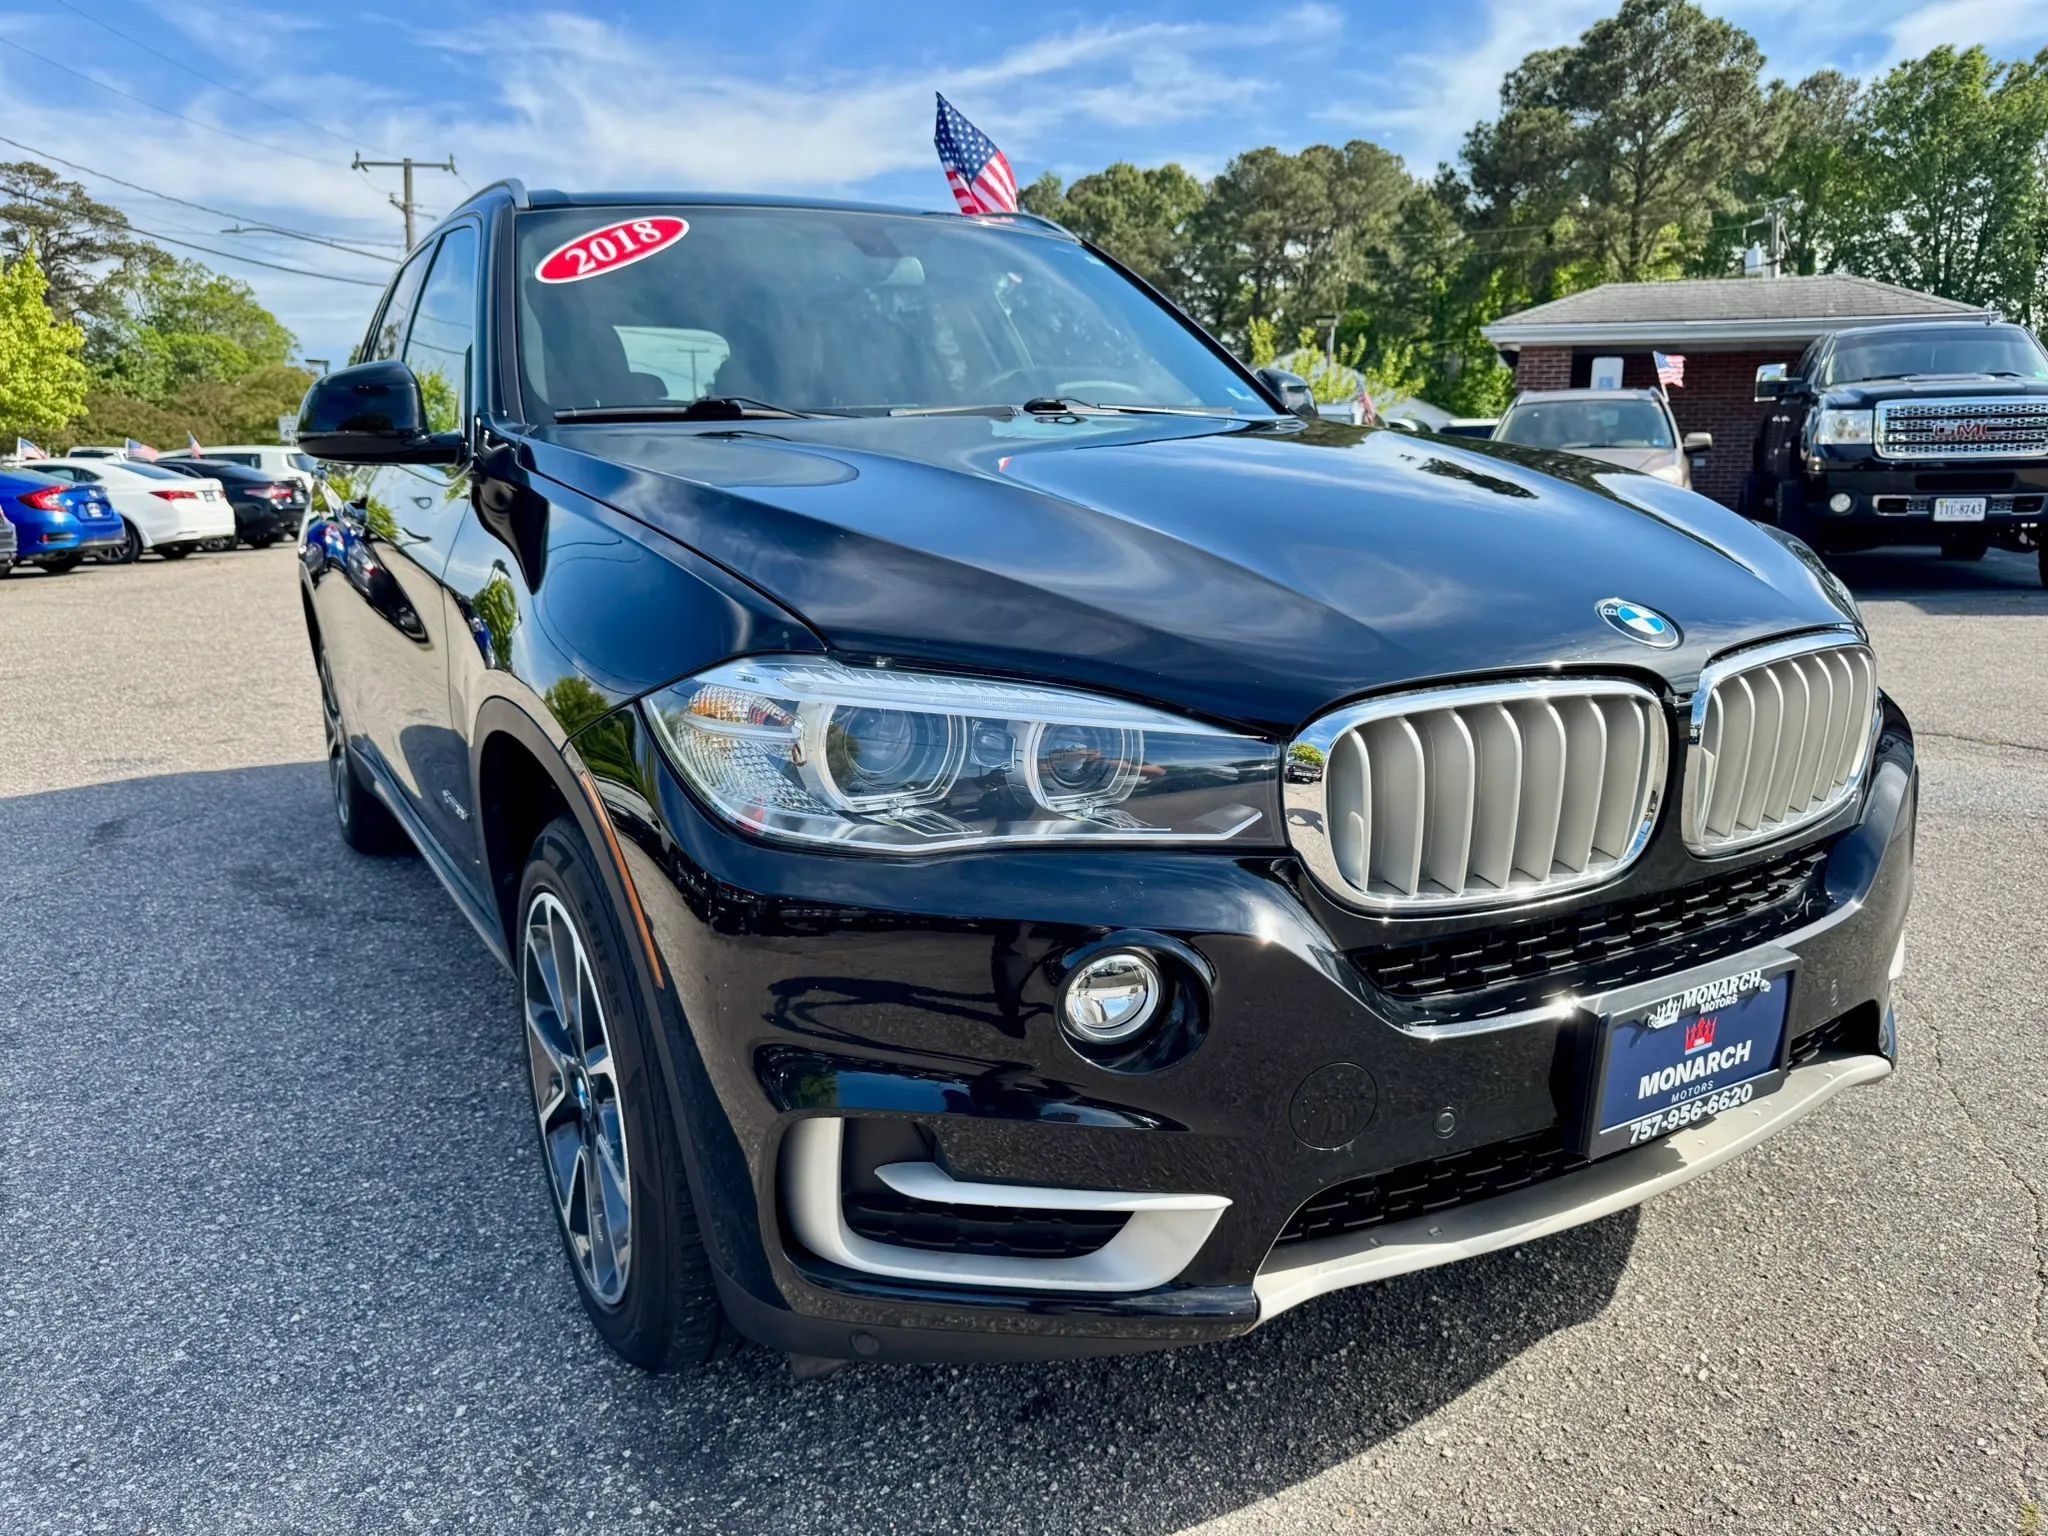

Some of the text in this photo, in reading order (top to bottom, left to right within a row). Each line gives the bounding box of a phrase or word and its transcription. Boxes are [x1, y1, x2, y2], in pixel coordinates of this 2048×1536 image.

[565, 220, 662, 275] 2018
[1933, 423, 2004, 437] GMC
[1682, 969, 1761, 1010] MONARCH
[1700, 994, 1738, 1014] MOTORS
[1638, 1040, 1752, 1100] MONARCH
[1671, 1080, 1714, 1103] MOTORS
[1630, 1083, 1753, 1144] 757-956-6620
